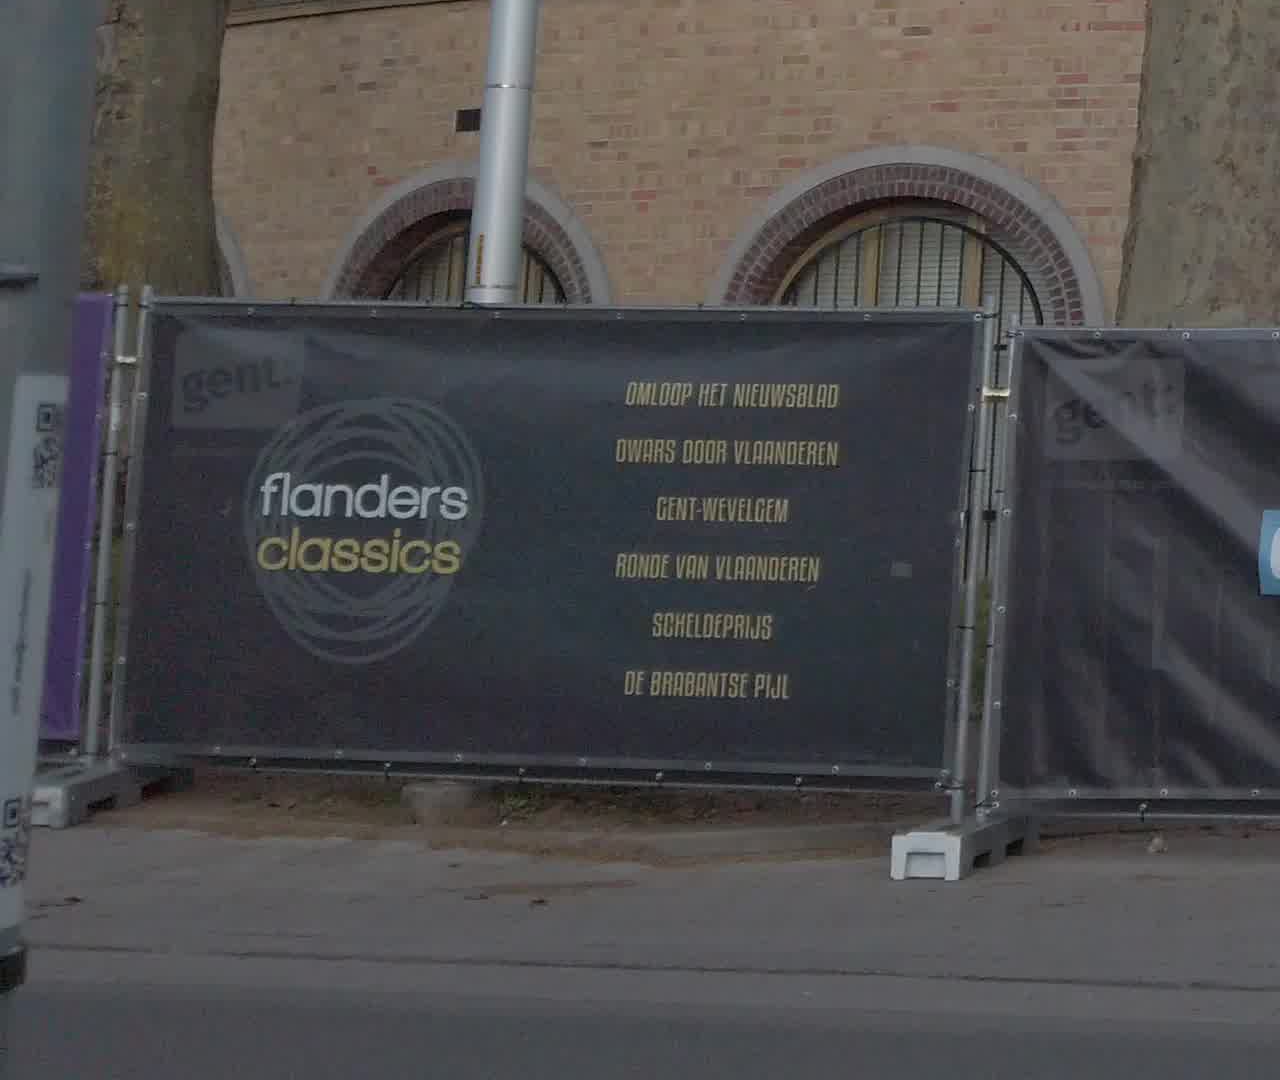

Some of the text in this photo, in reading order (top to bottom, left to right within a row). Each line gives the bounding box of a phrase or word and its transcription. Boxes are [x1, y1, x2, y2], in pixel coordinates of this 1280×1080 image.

[625, 381, 840, 409] OMLOOP HET NIEUWSBLAD
[615, 438, 840, 467] DWARS DOOR VLAANDEREN
[260, 471, 469, 520] flanders
[656, 495, 790, 524] GENT-WEVELGEM
[256, 526, 462, 575] classics
[615, 553, 821, 582] RONDE VAN VLAANDEREN
[652, 612, 773, 640] SCHELDEPRIJS
[624, 670, 792, 700] DE BRABANTSE PIJL
